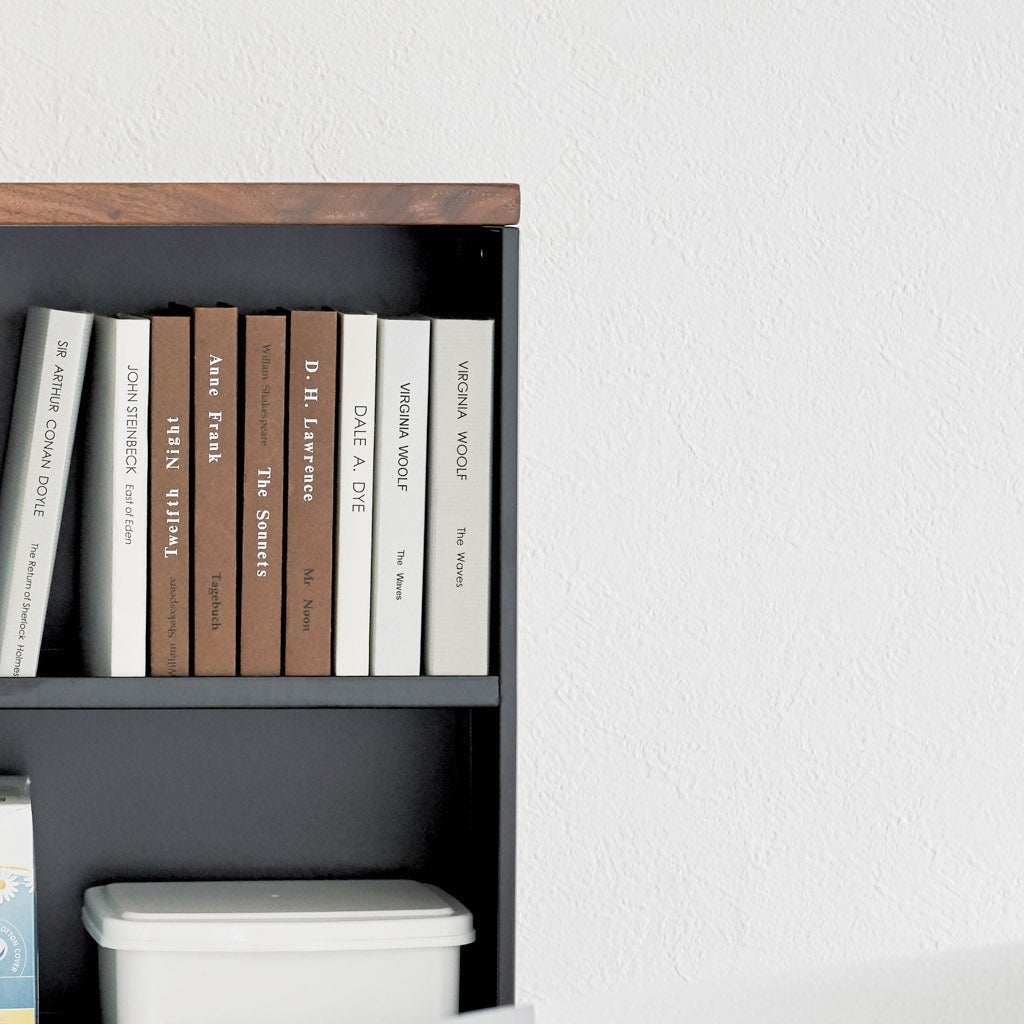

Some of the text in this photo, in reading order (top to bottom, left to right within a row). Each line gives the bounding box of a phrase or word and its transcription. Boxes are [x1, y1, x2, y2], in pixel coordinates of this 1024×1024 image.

[12, 340, 69, 677] SIR ARTHUR CONAN DOYLE The Return of Sherlock Holmes
[124, 365, 139, 545] JOHN STEINBECK East of Eden
[164, 488, 180, 559] Twelfth
[165, 416, 181, 470] Night
[208, 354, 223, 631] Anne Frank Tagebuch
[256, 344, 272, 577] William Shakespeare The Sonnets
[303, 360, 319, 632] D. H. Lawrence Mr Noon
[352, 405, 368, 512] DALE A. DYE
[395, 382, 411, 601] VIRGINIA WOOLF The Waves
[455, 360, 469, 588] VIRGINIA WOOLF The Waves
[167, 576, 179, 638] Shakespeare
[10, 948, 21, 973] COVER
